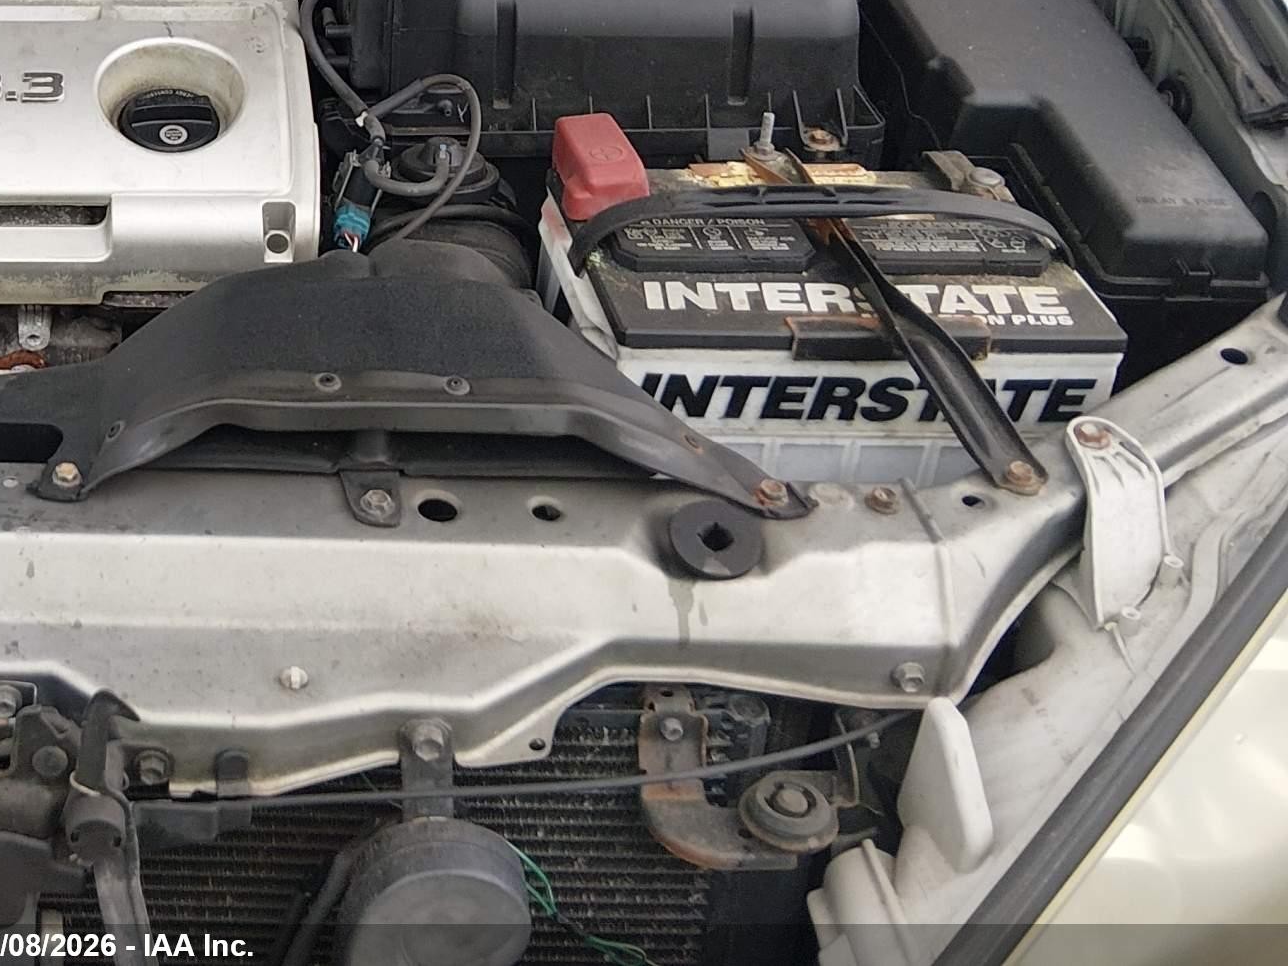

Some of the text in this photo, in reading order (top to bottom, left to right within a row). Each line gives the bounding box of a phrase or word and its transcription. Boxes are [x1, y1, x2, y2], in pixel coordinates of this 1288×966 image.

[652, 218, 704, 226] DANGER
[716, 218, 766, 226] POISON
[643, 281, 1070, 315] INTERTATE
[1012, 315, 1074, 326] PLUS
[641, 373, 1097, 422] NTERSTE
